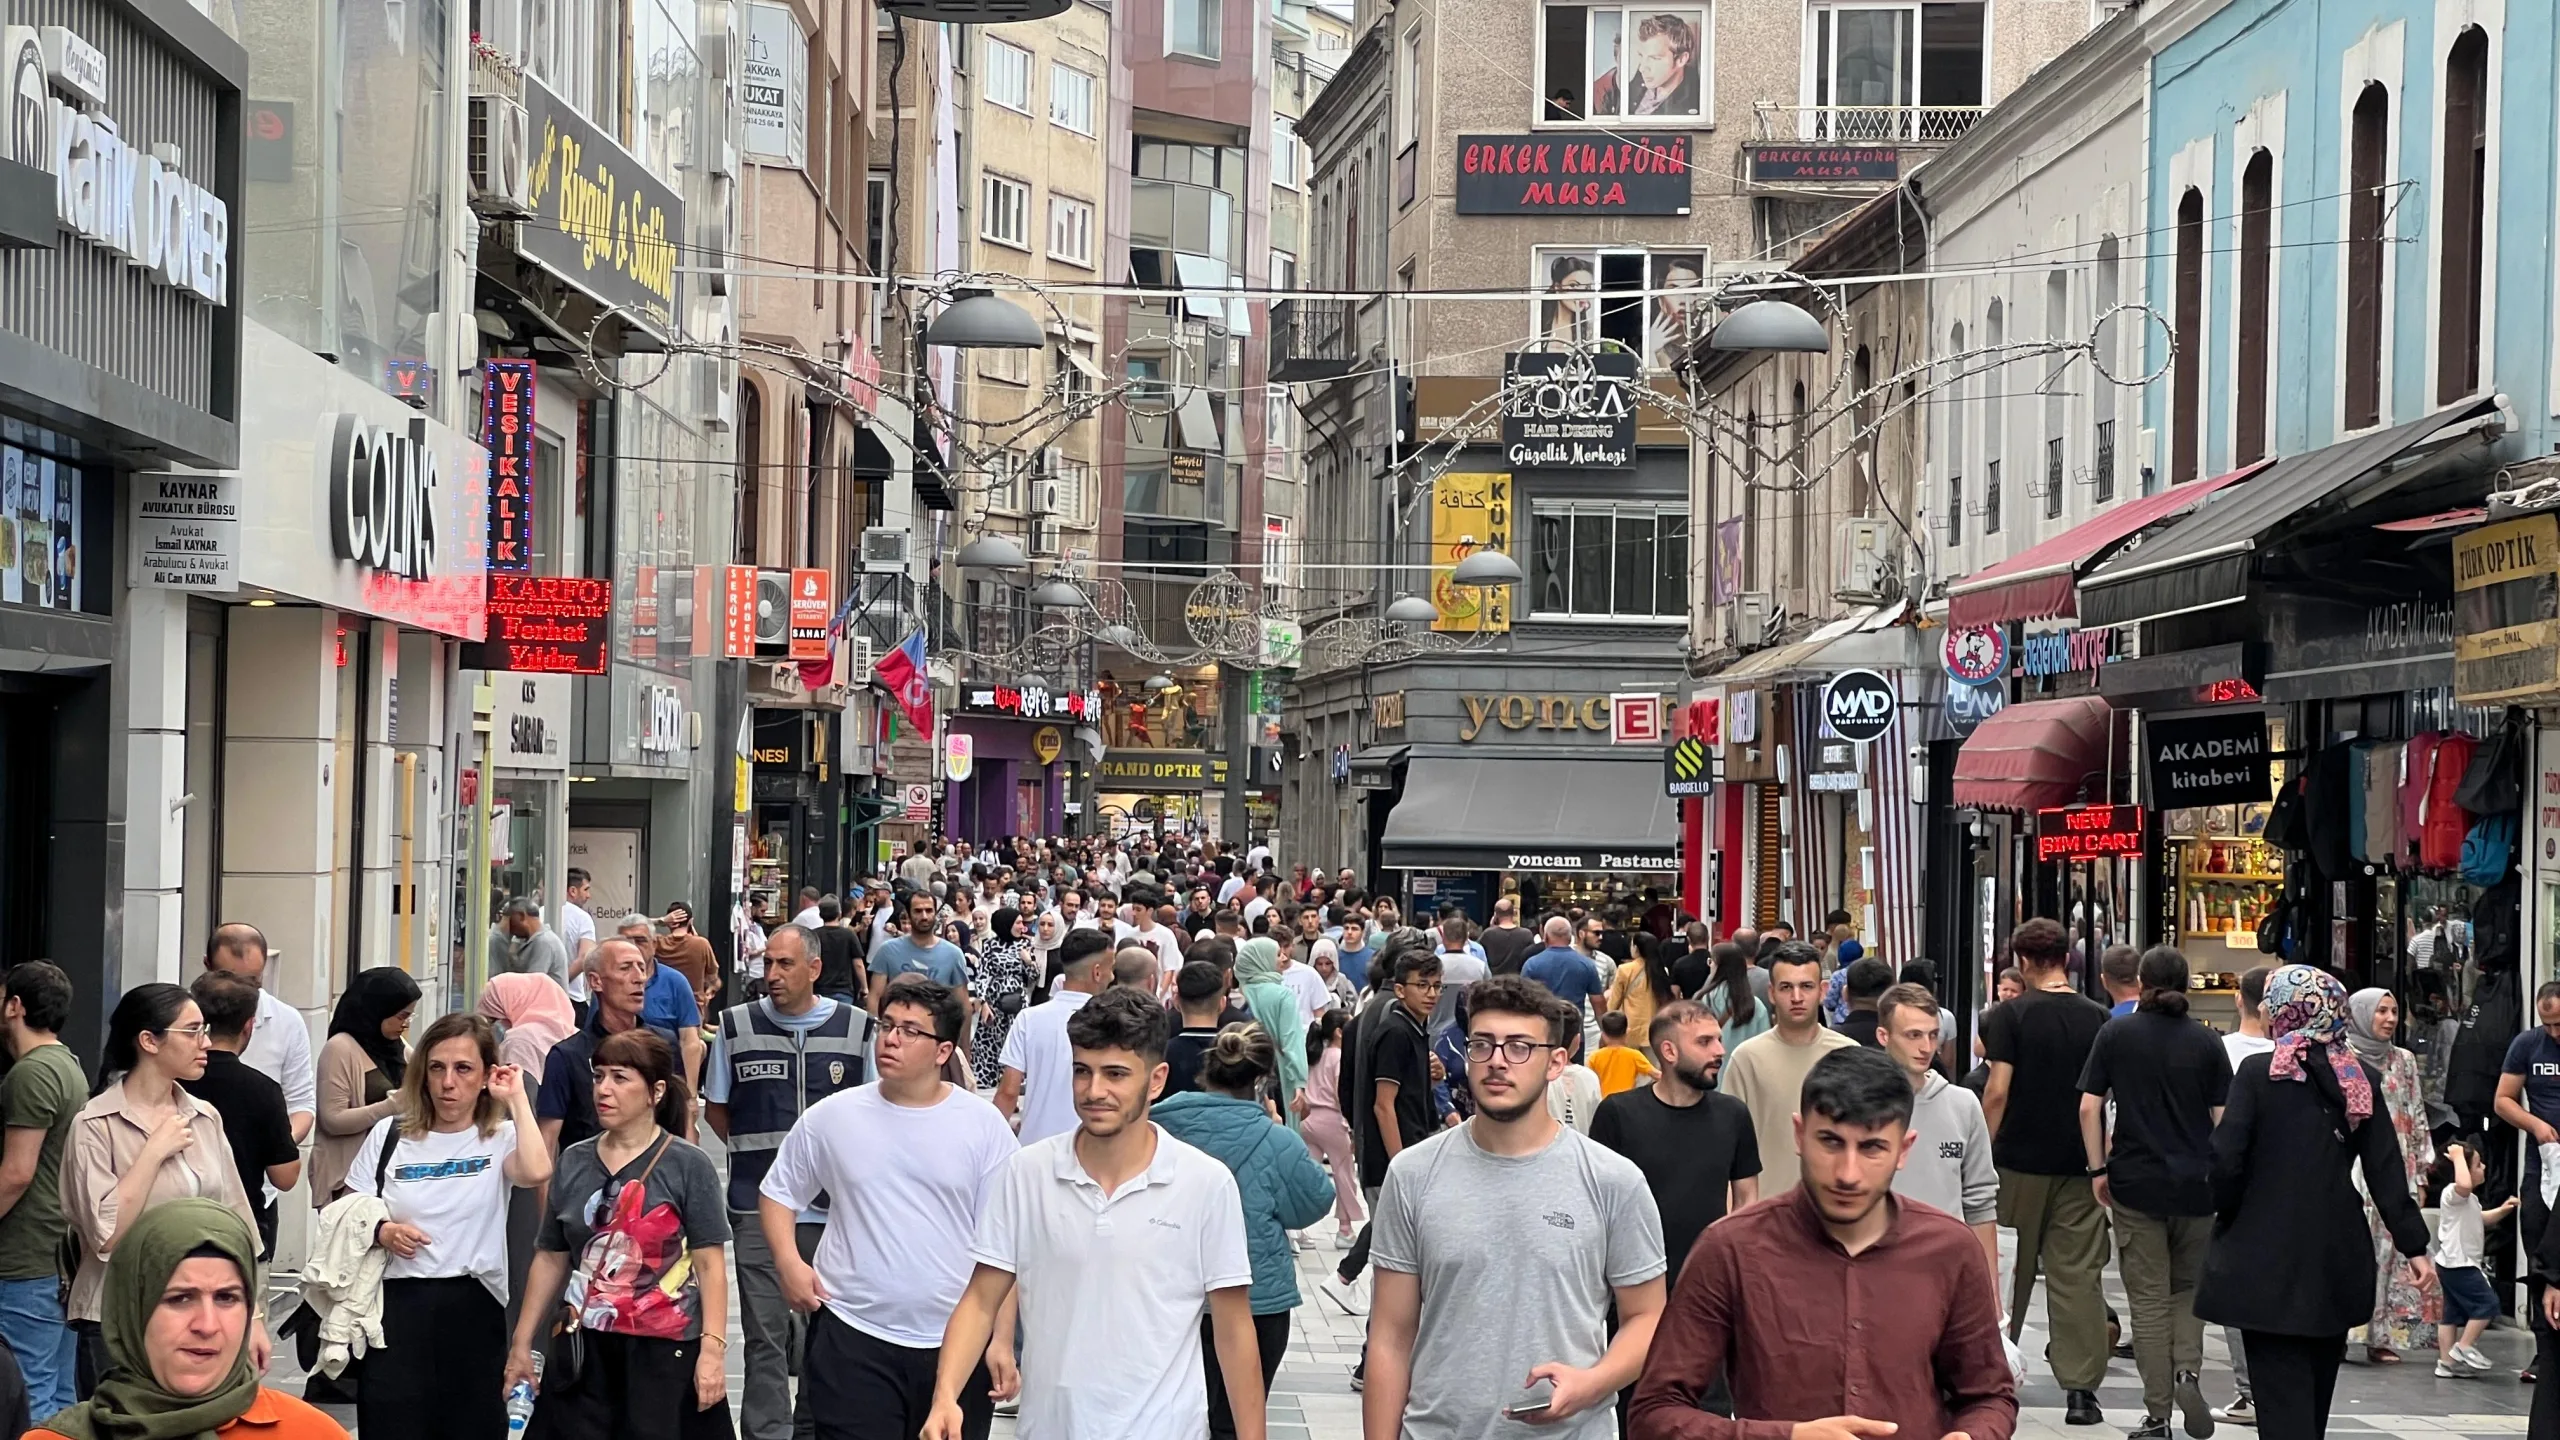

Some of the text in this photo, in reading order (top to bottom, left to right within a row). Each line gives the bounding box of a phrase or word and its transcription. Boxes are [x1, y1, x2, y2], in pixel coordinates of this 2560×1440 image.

[1463, 136, 1686, 175] ERKEK KUAFÖRÜ
[1758, 151, 1813, 163] ERKEK
[1793, 166, 1860, 176] MUSA
[559, 134, 615, 271] Birgül
[1520, 182, 1627, 206] MUSA
[1523, 423, 1561, 438] HAIR
[1509, 442, 1628, 466] Güzellik Merkezi
[159, 481, 218, 500] KAYNAR
[1439, 489, 1486, 509] كنافة
[142, 502, 236, 516] AVUKATLIK BÜROSU
[170, 524, 204, 537] Avukat
[156, 536, 218, 552] İsmail KAYNAR
[2486, 531, 2537, 574] OPTİK
[143, 556, 229, 570] Arabulucu & Avukat
[154, 572, 217, 585] Ali Can KAYNAR
[728, 568, 738, 654] SERÜVEN
[743, 569, 753, 655] KİTABEVİ
[793, 598, 827, 610] SERÜVEN
[502, 616, 589, 642] Ferhat
[2364, 589, 2422, 653] AKADEMİ
[792, 628, 826, 638] SAHAF
[1830, 687, 1890, 718] MAD
[1624, 704, 1650, 734] E
[2158, 731, 2260, 763] AKADEMİ
[1103, 762, 1150, 776] RAND
[2172, 766, 2251, 790] kitabevi
[1669, 782, 1709, 794] BARGELLO
[2066, 812, 2112, 830] NEW
[568, 843, 588, 854] rkek
[2041, 832, 2139, 854] SIM CART
[1508, 852, 1582, 869] yoncam
[742, 1064, 781, 1077] POLIS
